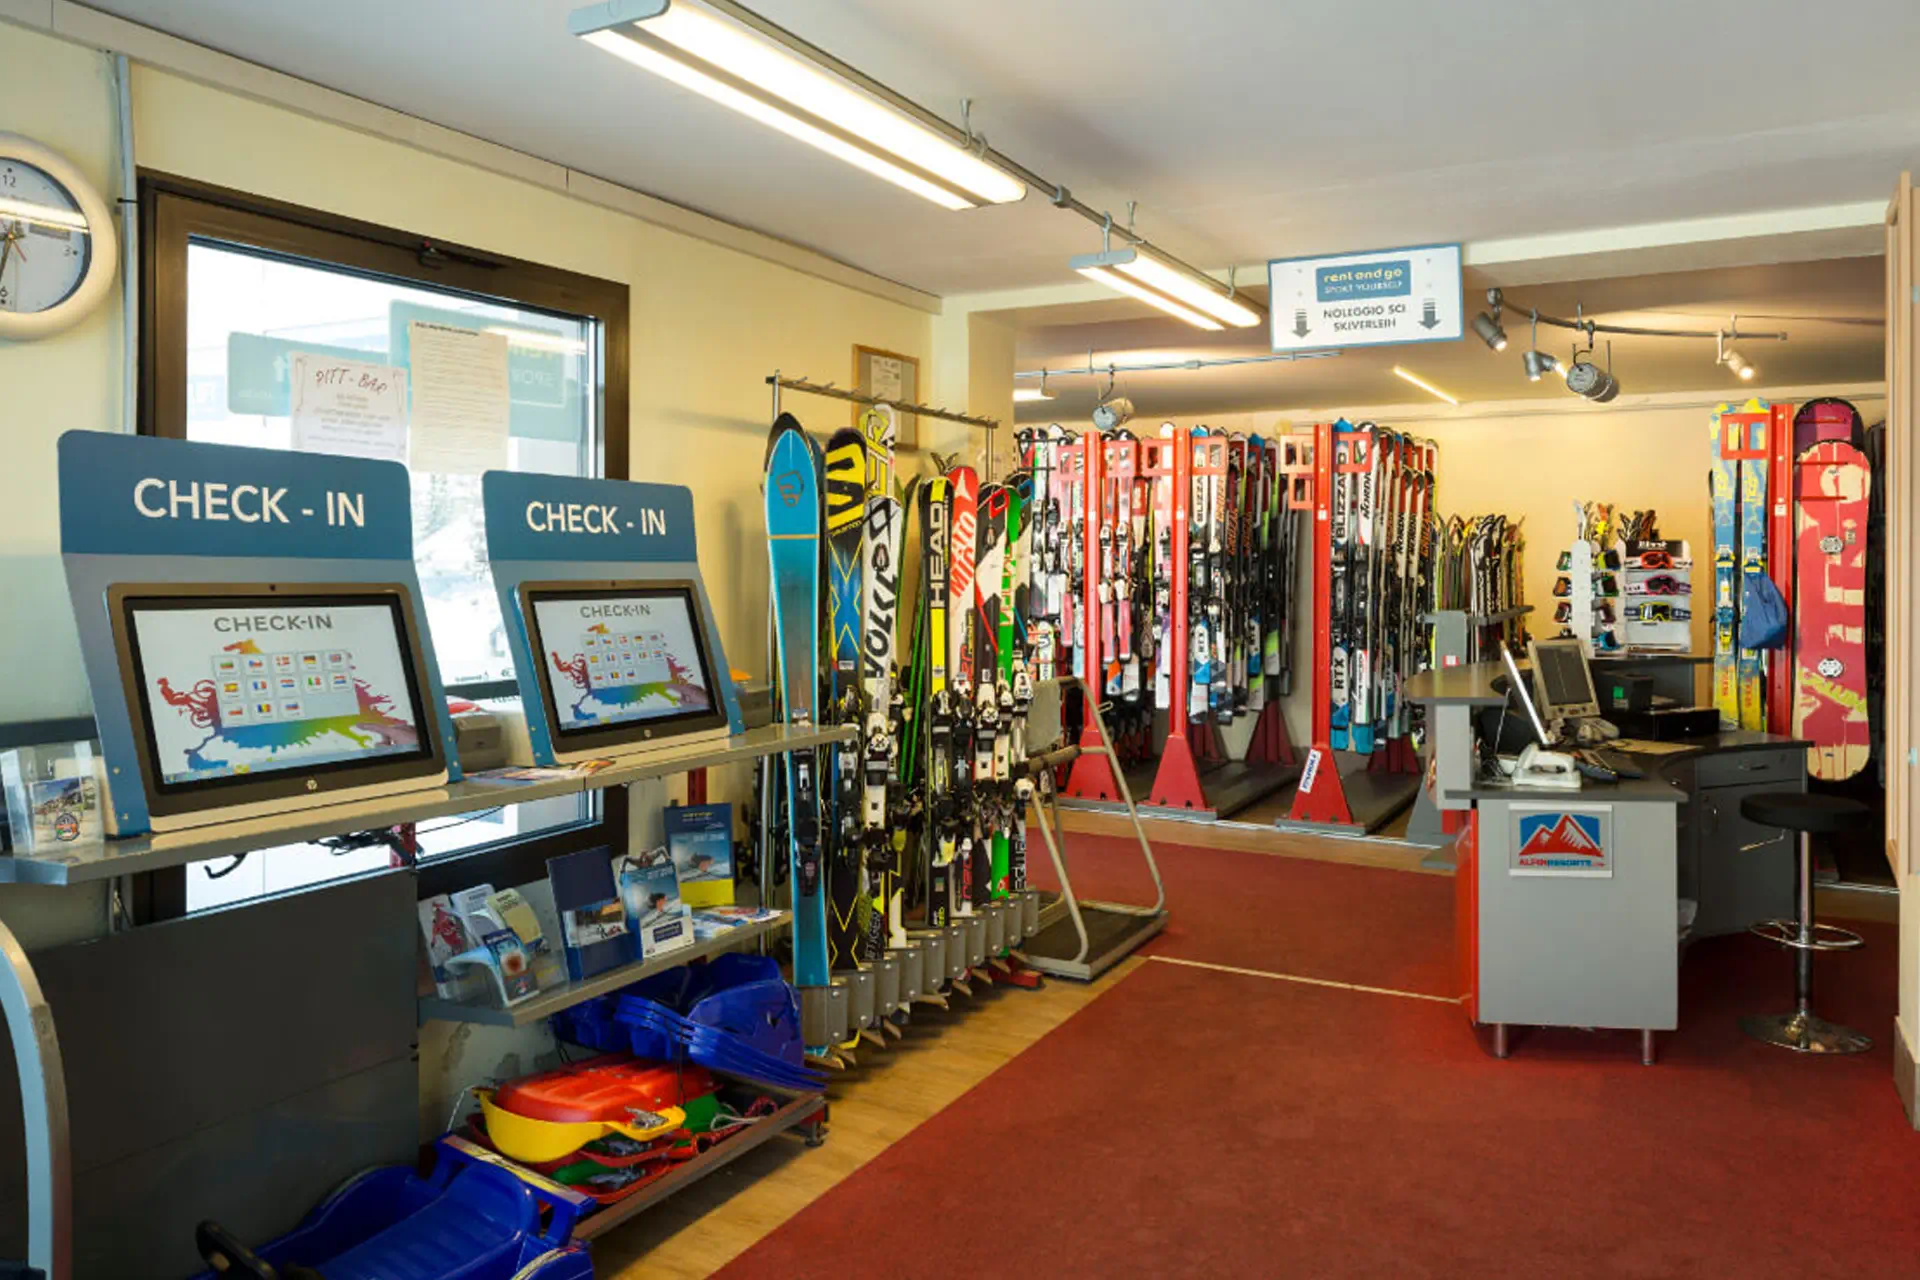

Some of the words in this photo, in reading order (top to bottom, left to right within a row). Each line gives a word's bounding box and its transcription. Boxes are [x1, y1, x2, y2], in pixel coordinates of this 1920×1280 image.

[2, 174, 16, 188] 12
[1323, 271, 1354, 283] rent
[1384, 267, 1403, 282] go
[1323, 306, 1385, 319] NOLEGGIO
[1388, 303, 1407, 314] SCI
[1333, 318, 1397, 333] SKIVERLEIH
[133, 477, 291, 524] CHECK
[325, 491, 366, 528] IN
[1336, 452, 1348, 539] BLIZZAD
[525, 501, 621, 535] CHECK
[640, 507, 667, 536] IN
[930, 502, 947, 608] HEAD
[579, 603, 652, 619] CHECK-IN
[213, 613, 334, 633] CHECK-IN
[1334, 657, 1345, 690] RTX
